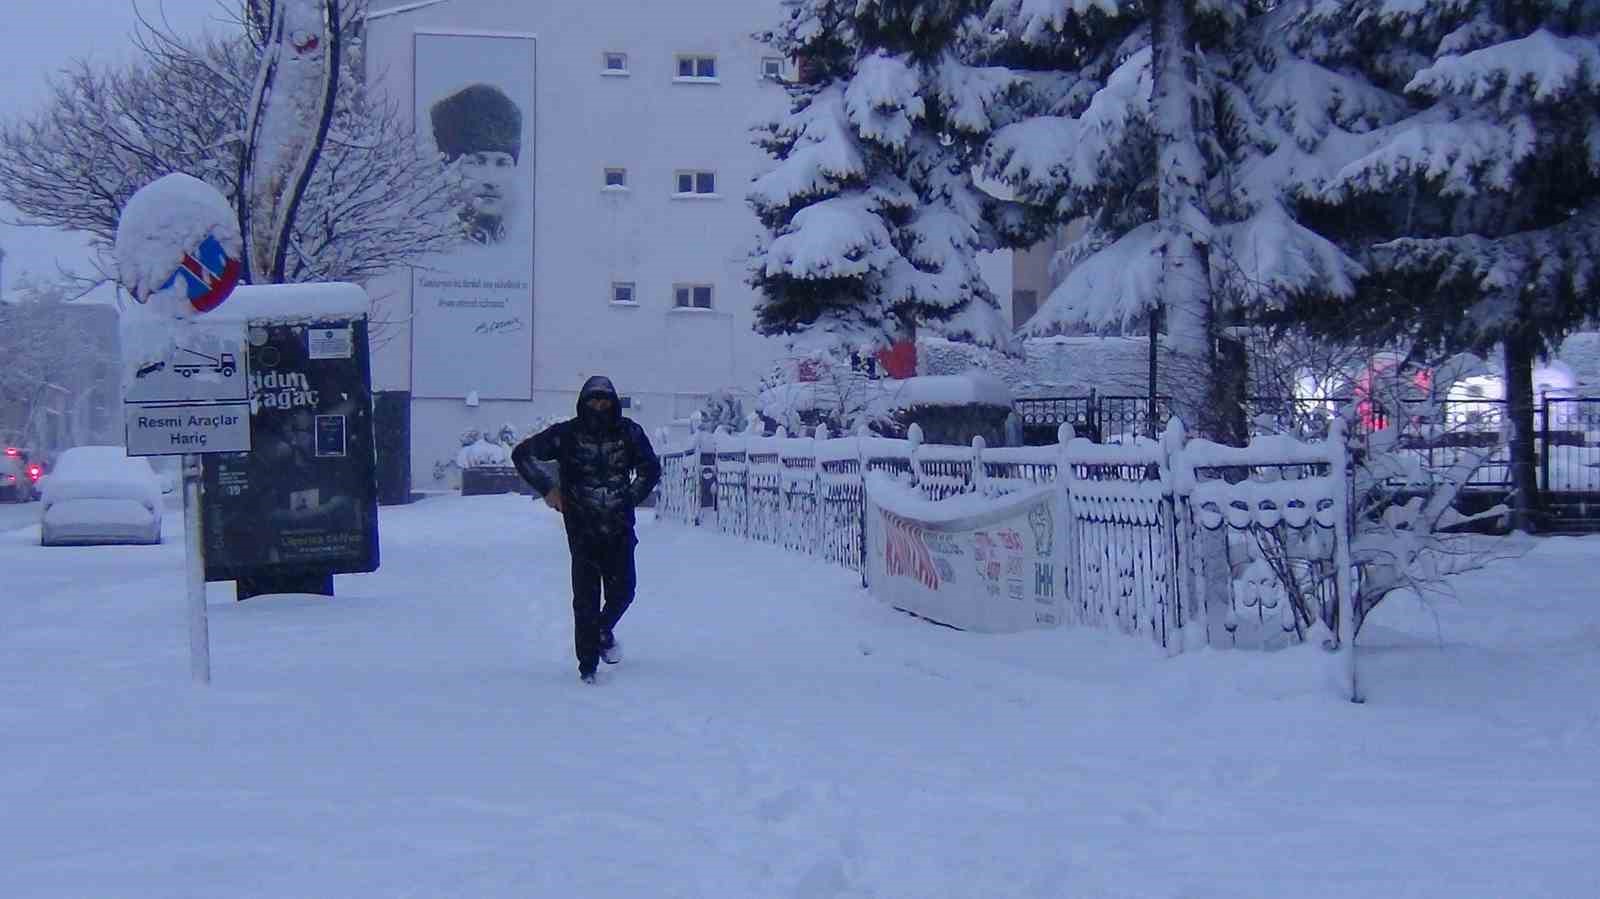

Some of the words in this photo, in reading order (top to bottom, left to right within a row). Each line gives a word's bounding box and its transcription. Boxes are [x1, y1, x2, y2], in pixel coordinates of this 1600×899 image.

[138, 415, 182, 428] Resmi
[188, 414, 239, 430] Araçlar
[170, 432, 207, 446] Hariç
